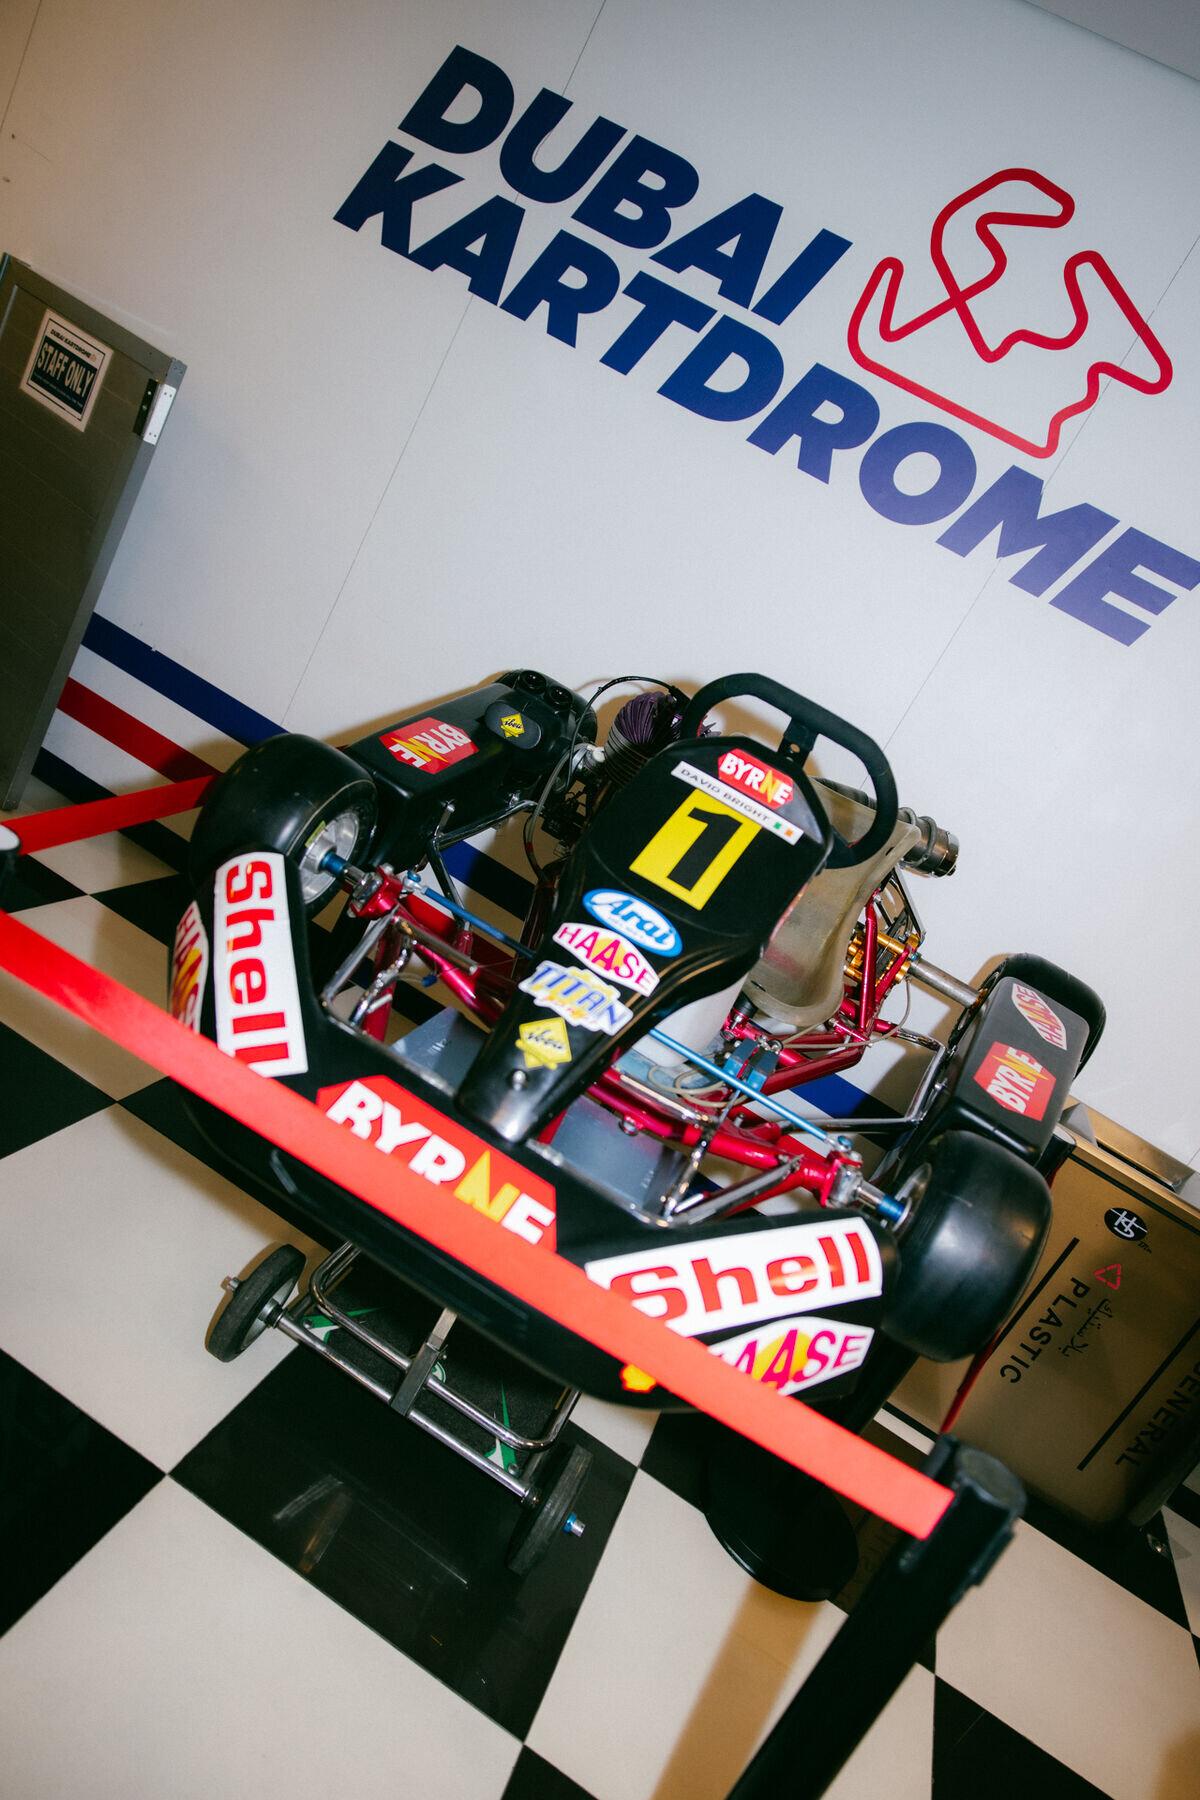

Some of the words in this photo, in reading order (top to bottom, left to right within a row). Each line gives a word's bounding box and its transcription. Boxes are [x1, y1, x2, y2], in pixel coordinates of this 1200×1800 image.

[399, 44, 853, 326] DUBAI
[37, 342, 69, 380] STAFF
[64, 361, 94, 398] ONLY
[332, 140, 1200, 647] KARTDROME
[389, 723, 471, 768] BYRNE
[680, 768, 721, 793] DAVID
[722, 791, 770, 822] BRIGHT
[720, 753, 793, 806] BYRNE
[667, 806, 742, 892] 1
[596, 897, 673, 945] Arai
[173, 909, 203, 1031] HAAS
[226, 861, 289, 1064] Shell
[559, 926, 653, 987] HAASE
[529, 966, 619, 1025] TITAN
[987, 1047, 1047, 1113] BYRNE
[610, 1232, 870, 1322] Shell
[1000, 1277, 1090, 1383] PLASTIC
[1058, 1299, 1113, 1357] بلاستيك
[720, 1329, 867, 1392] AASE
